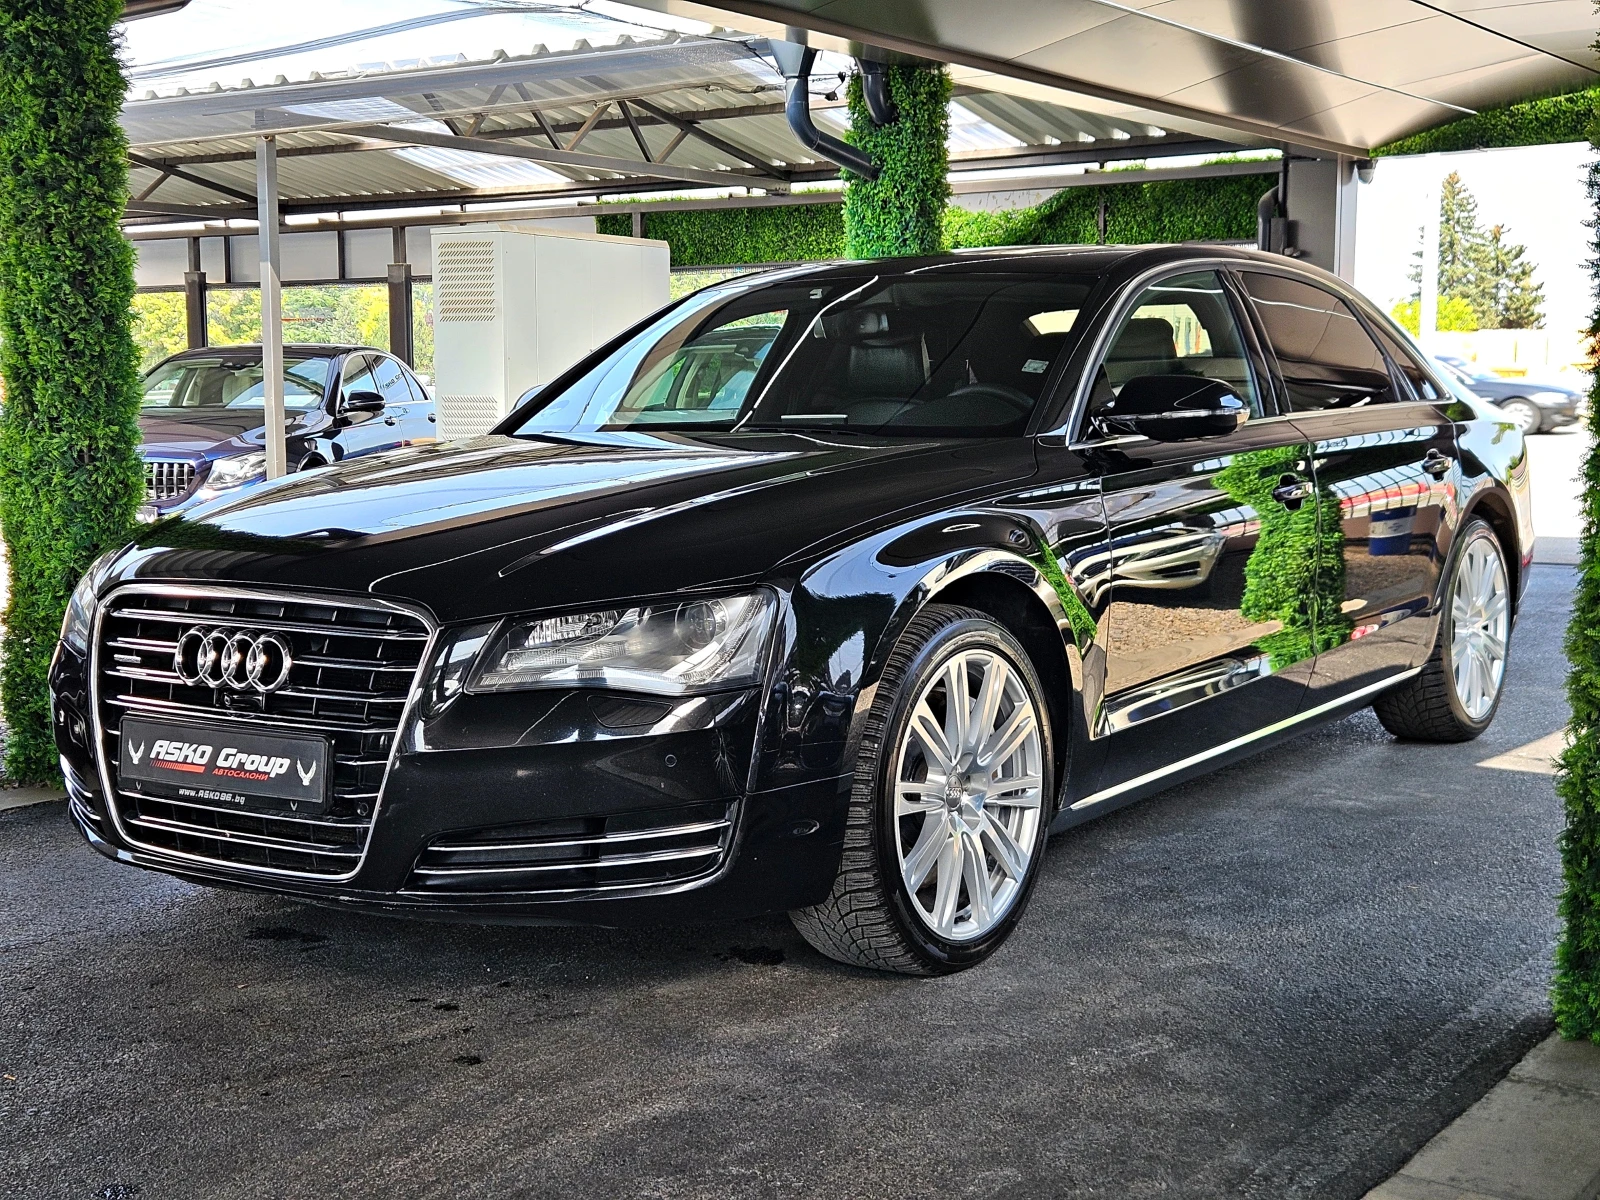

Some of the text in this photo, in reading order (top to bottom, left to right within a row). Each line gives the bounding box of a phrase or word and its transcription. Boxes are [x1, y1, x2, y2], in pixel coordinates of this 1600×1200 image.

[150, 739, 291, 777] ASKO Group
[212, 768, 269, 781] АВТОСАЛОНИ
[178, 788, 246, 805] www.ASKO96.bg
